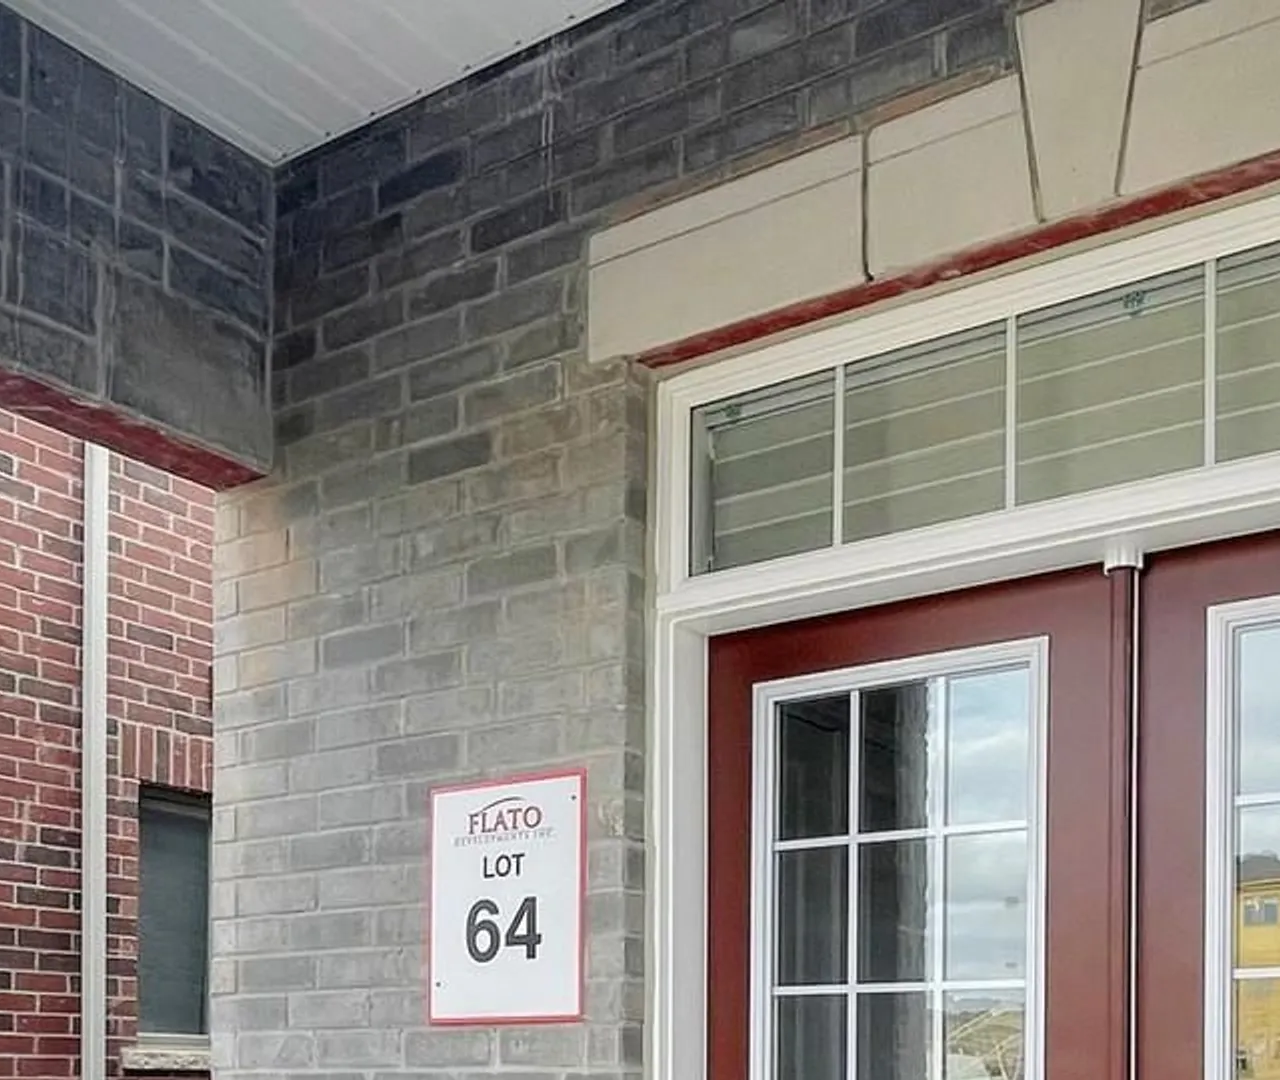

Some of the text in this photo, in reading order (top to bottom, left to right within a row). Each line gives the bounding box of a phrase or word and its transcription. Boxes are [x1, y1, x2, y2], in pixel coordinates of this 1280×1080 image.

[467, 806, 543, 835] FLATO
[483, 853, 525, 879] LOT
[466, 896, 542, 964] 64
